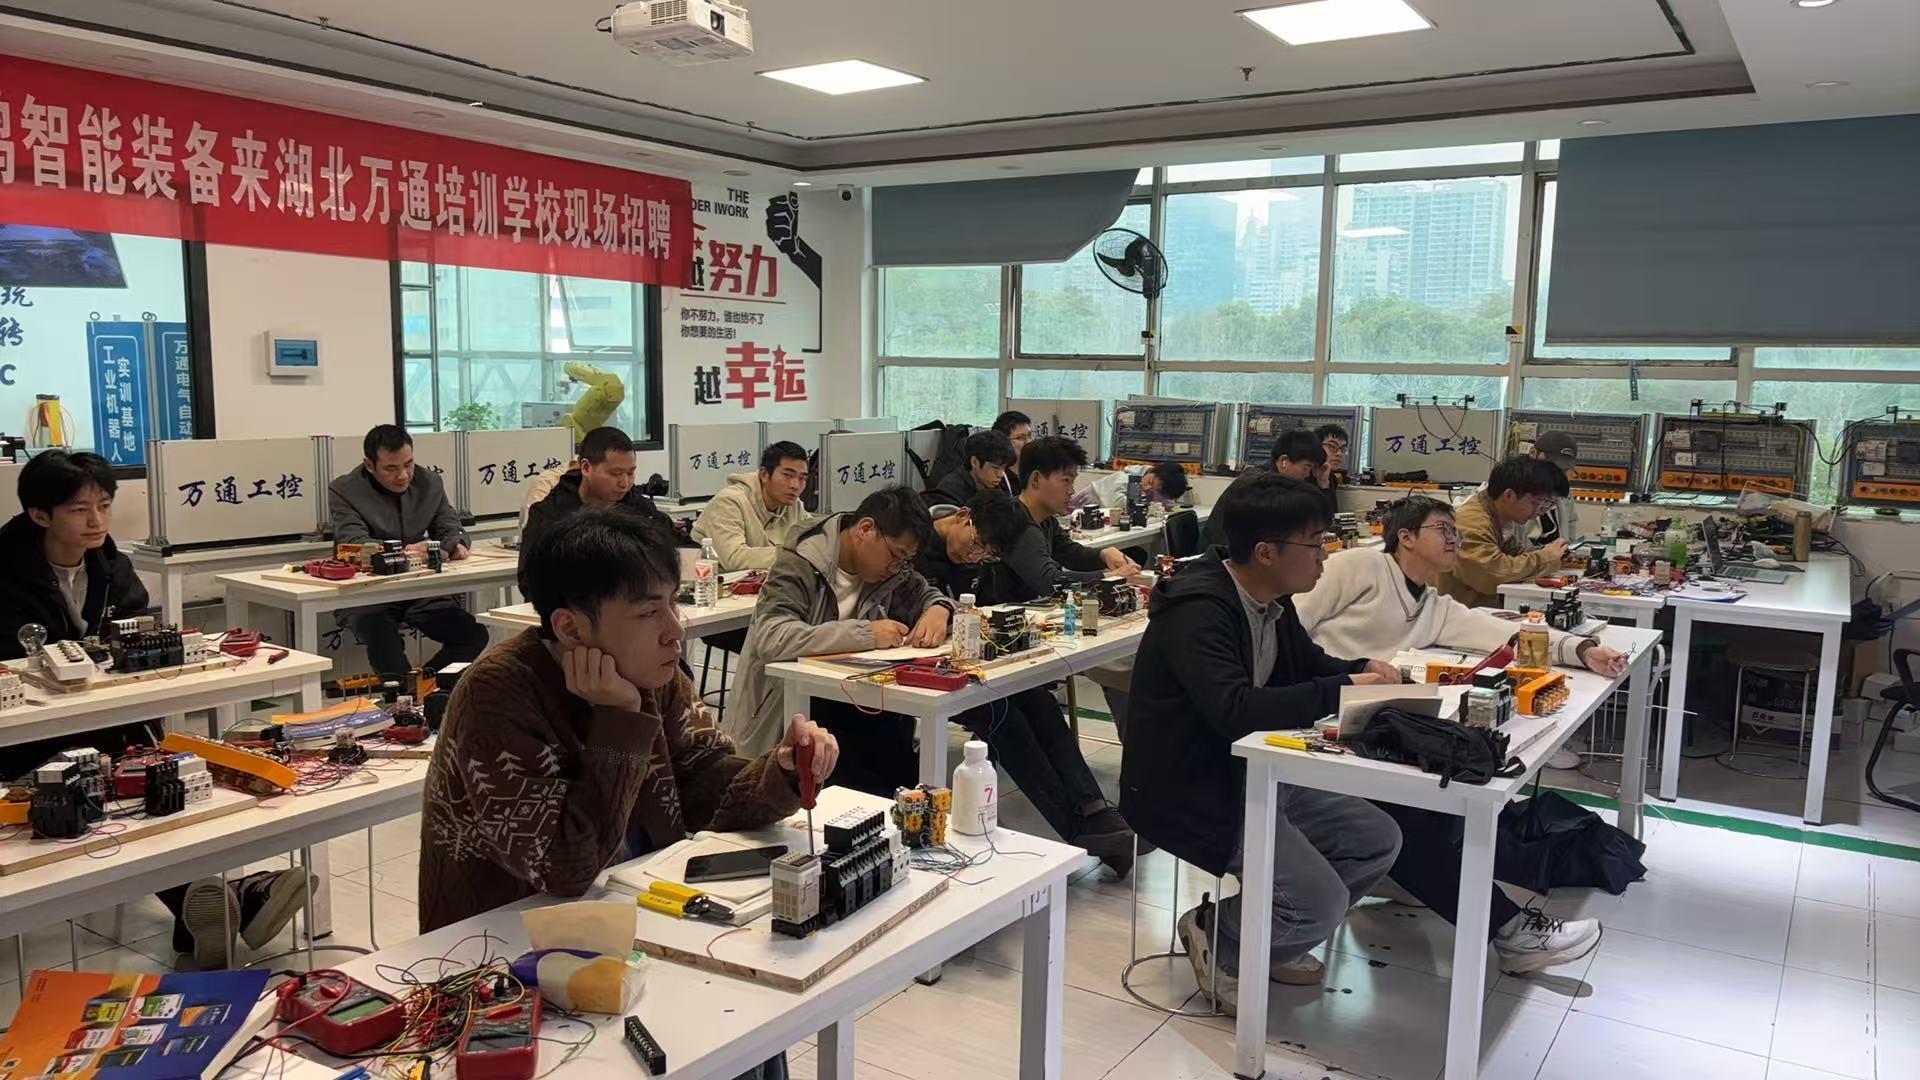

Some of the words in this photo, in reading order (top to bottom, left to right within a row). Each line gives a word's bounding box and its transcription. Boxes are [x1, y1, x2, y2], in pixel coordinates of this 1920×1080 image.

[727, 188, 749, 204] THE
[174, 340, 192, 440] 万通电气自动
[694, 341, 808, 409] 越幸运
[102, 345, 123, 462] 工业机器人
[117, 356, 136, 452] 实训基地
[690, 449, 751, 470] 万通工控
[1385, 433, 1482, 455] 万通工控
[837, 460, 896, 485] 万通工控
[178, 473, 304, 507] 万通工控
